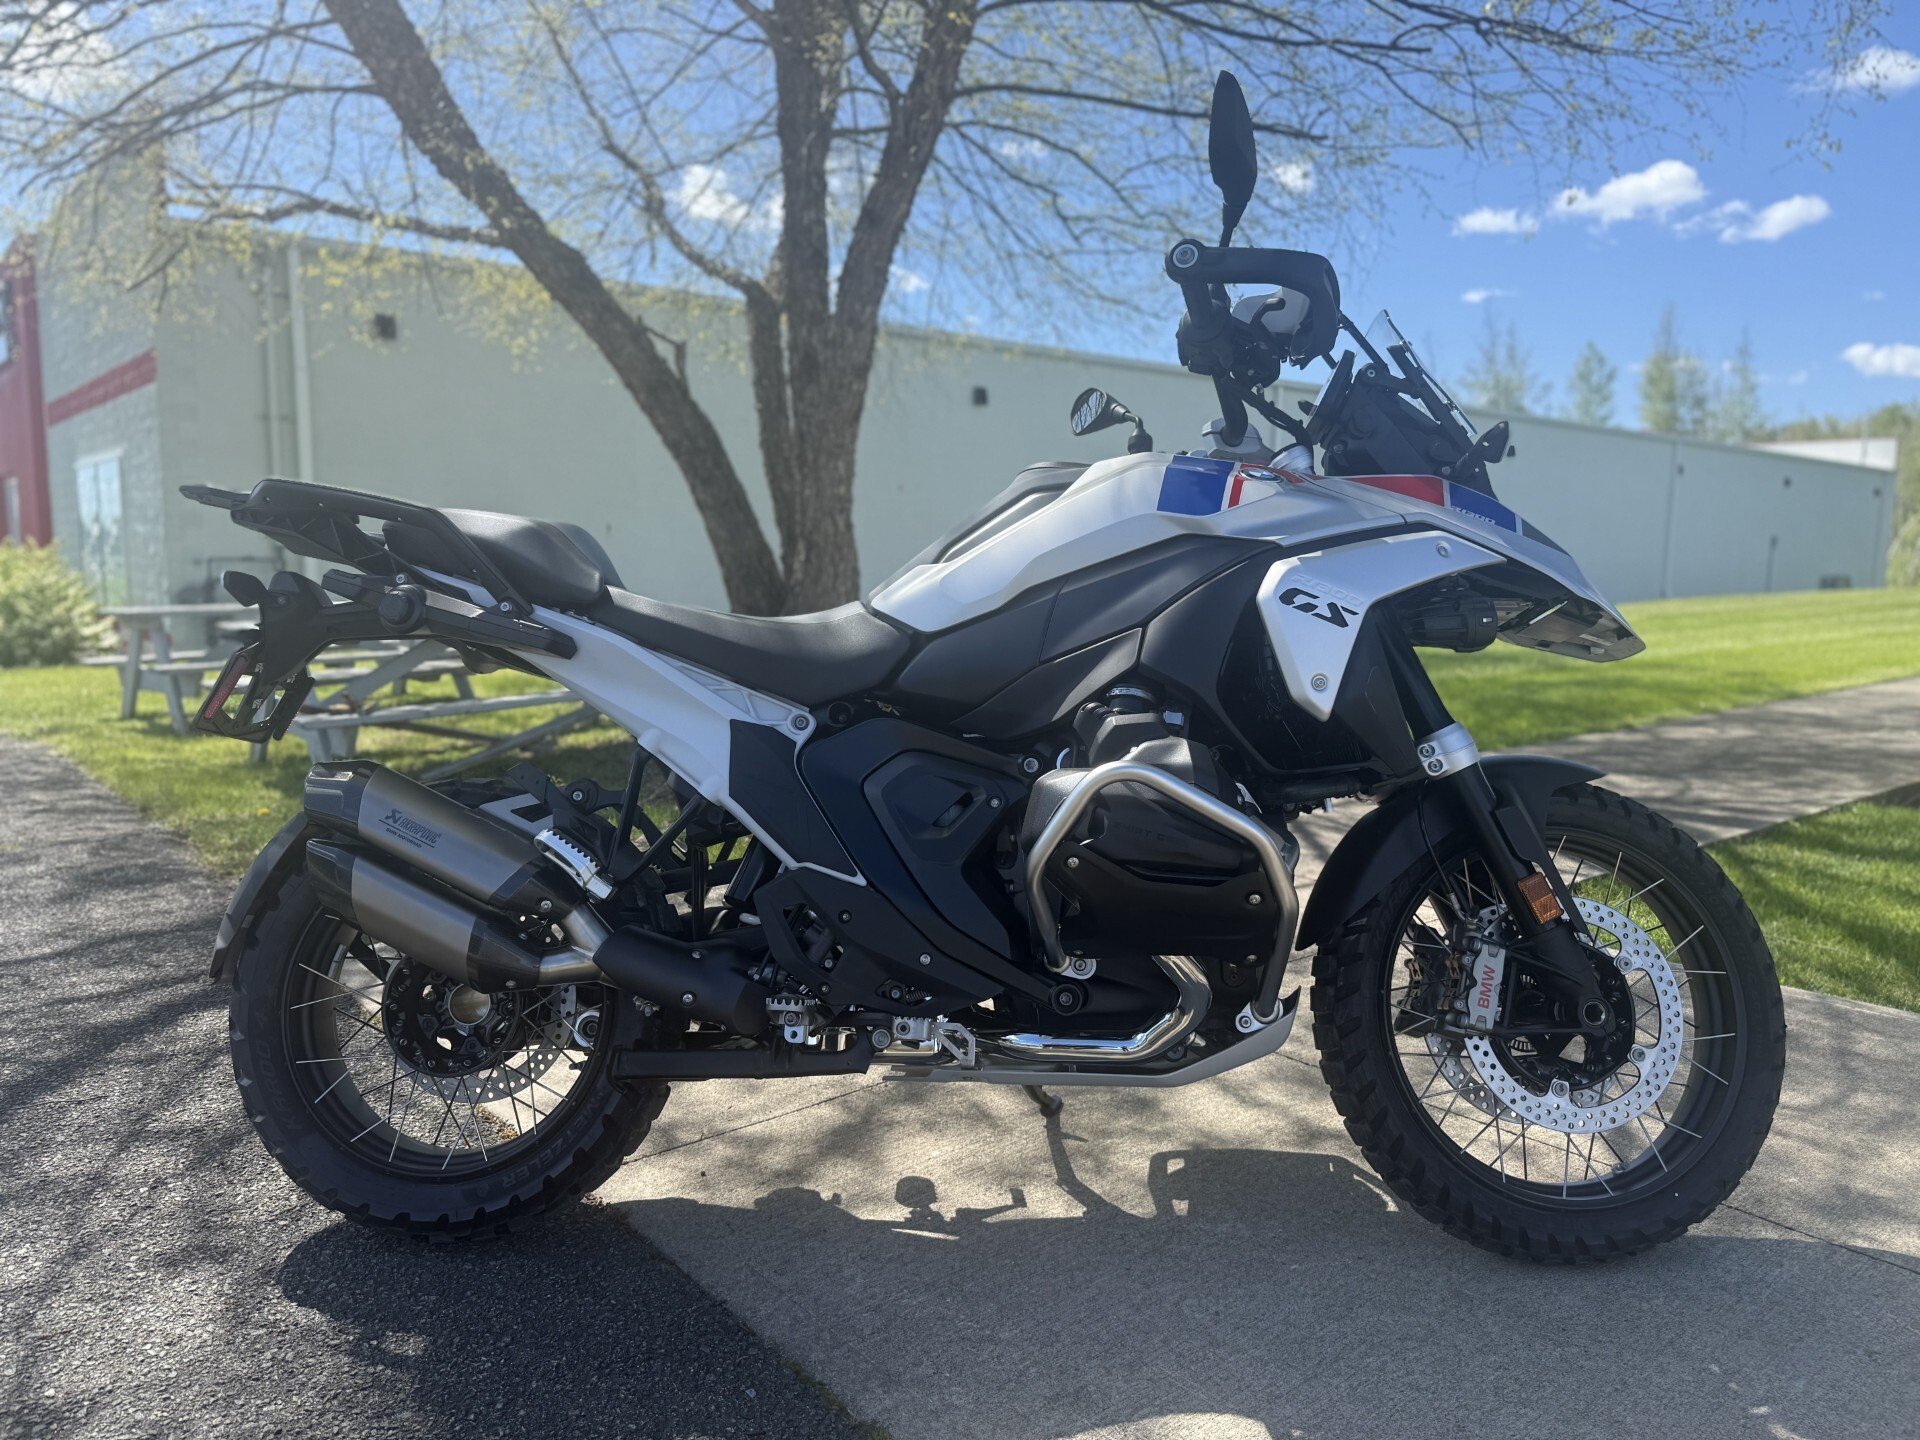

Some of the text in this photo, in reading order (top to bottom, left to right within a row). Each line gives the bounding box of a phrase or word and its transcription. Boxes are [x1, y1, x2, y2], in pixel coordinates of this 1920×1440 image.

[1279, 587, 1360, 628] GS
[397, 833, 422, 849] MOTORRAD
[1477, 964, 1496, 1010] BMW
